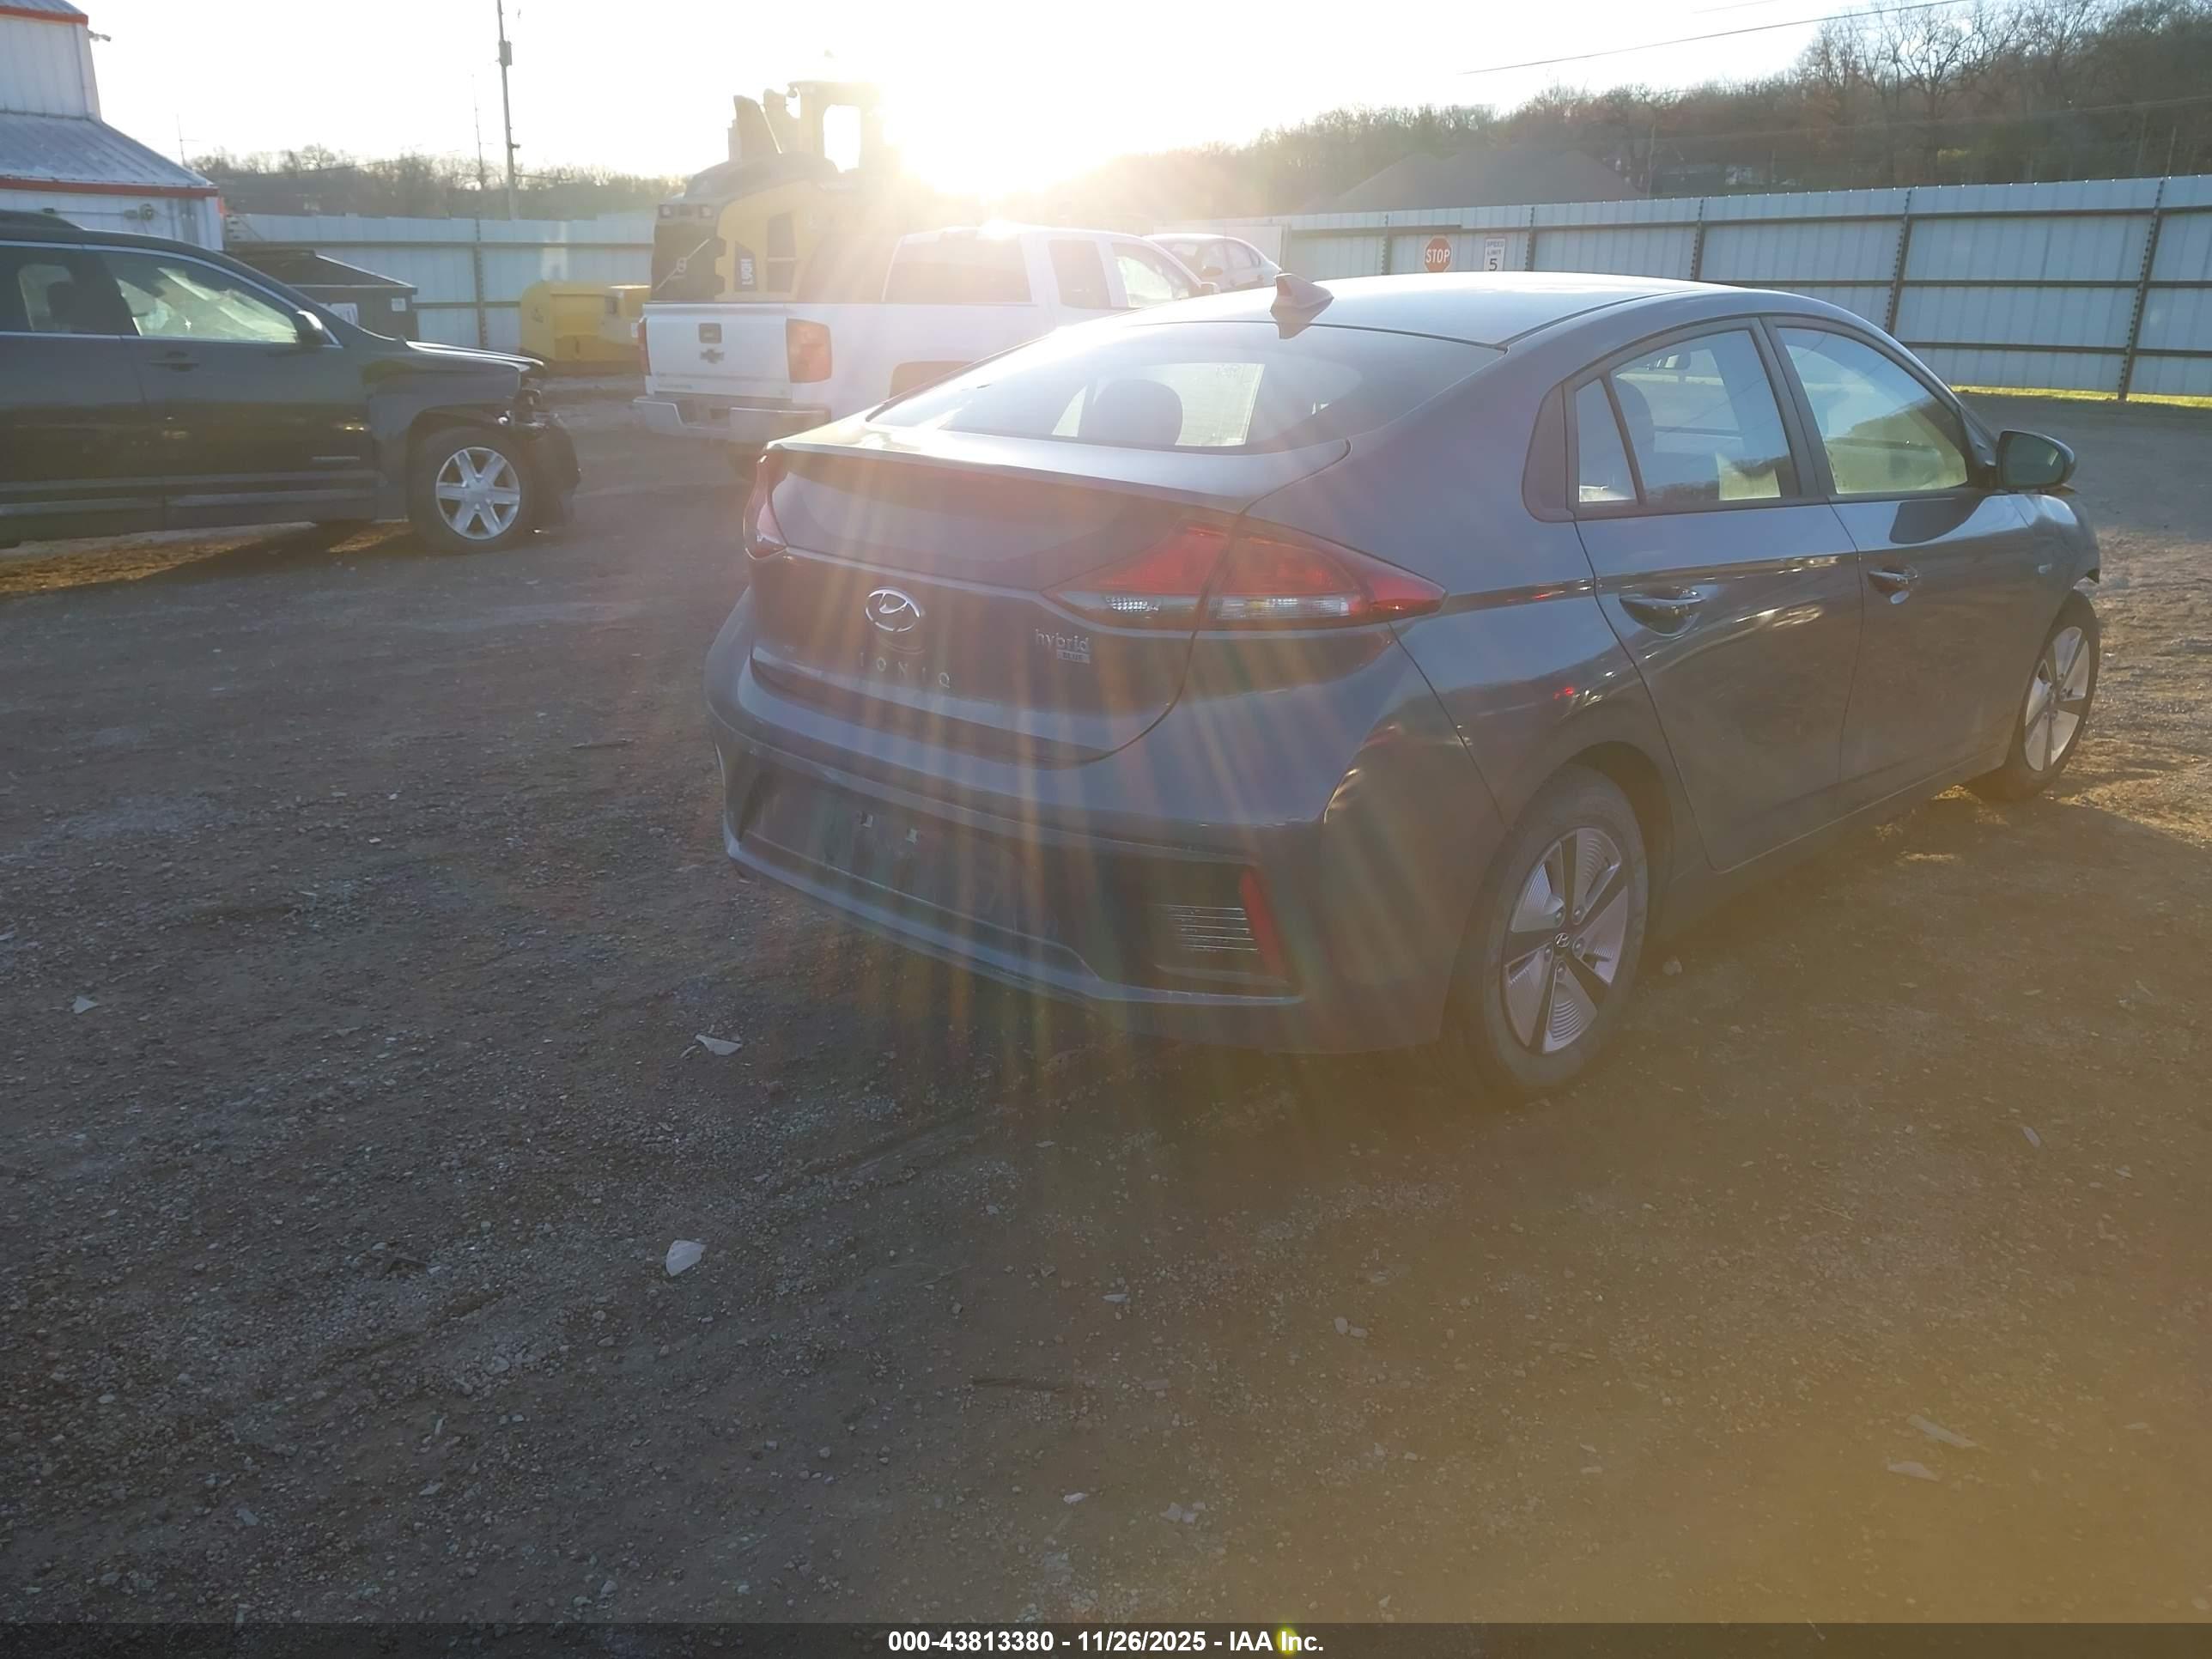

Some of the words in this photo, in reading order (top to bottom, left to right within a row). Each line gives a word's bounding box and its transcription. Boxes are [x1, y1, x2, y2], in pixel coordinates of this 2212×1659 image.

[1425, 249, 1451, 263] STOP
[1489, 258, 1498, 272] 5
[1036, 629, 1090, 653] hybrid
[860, 652, 951, 689] IONIQ
